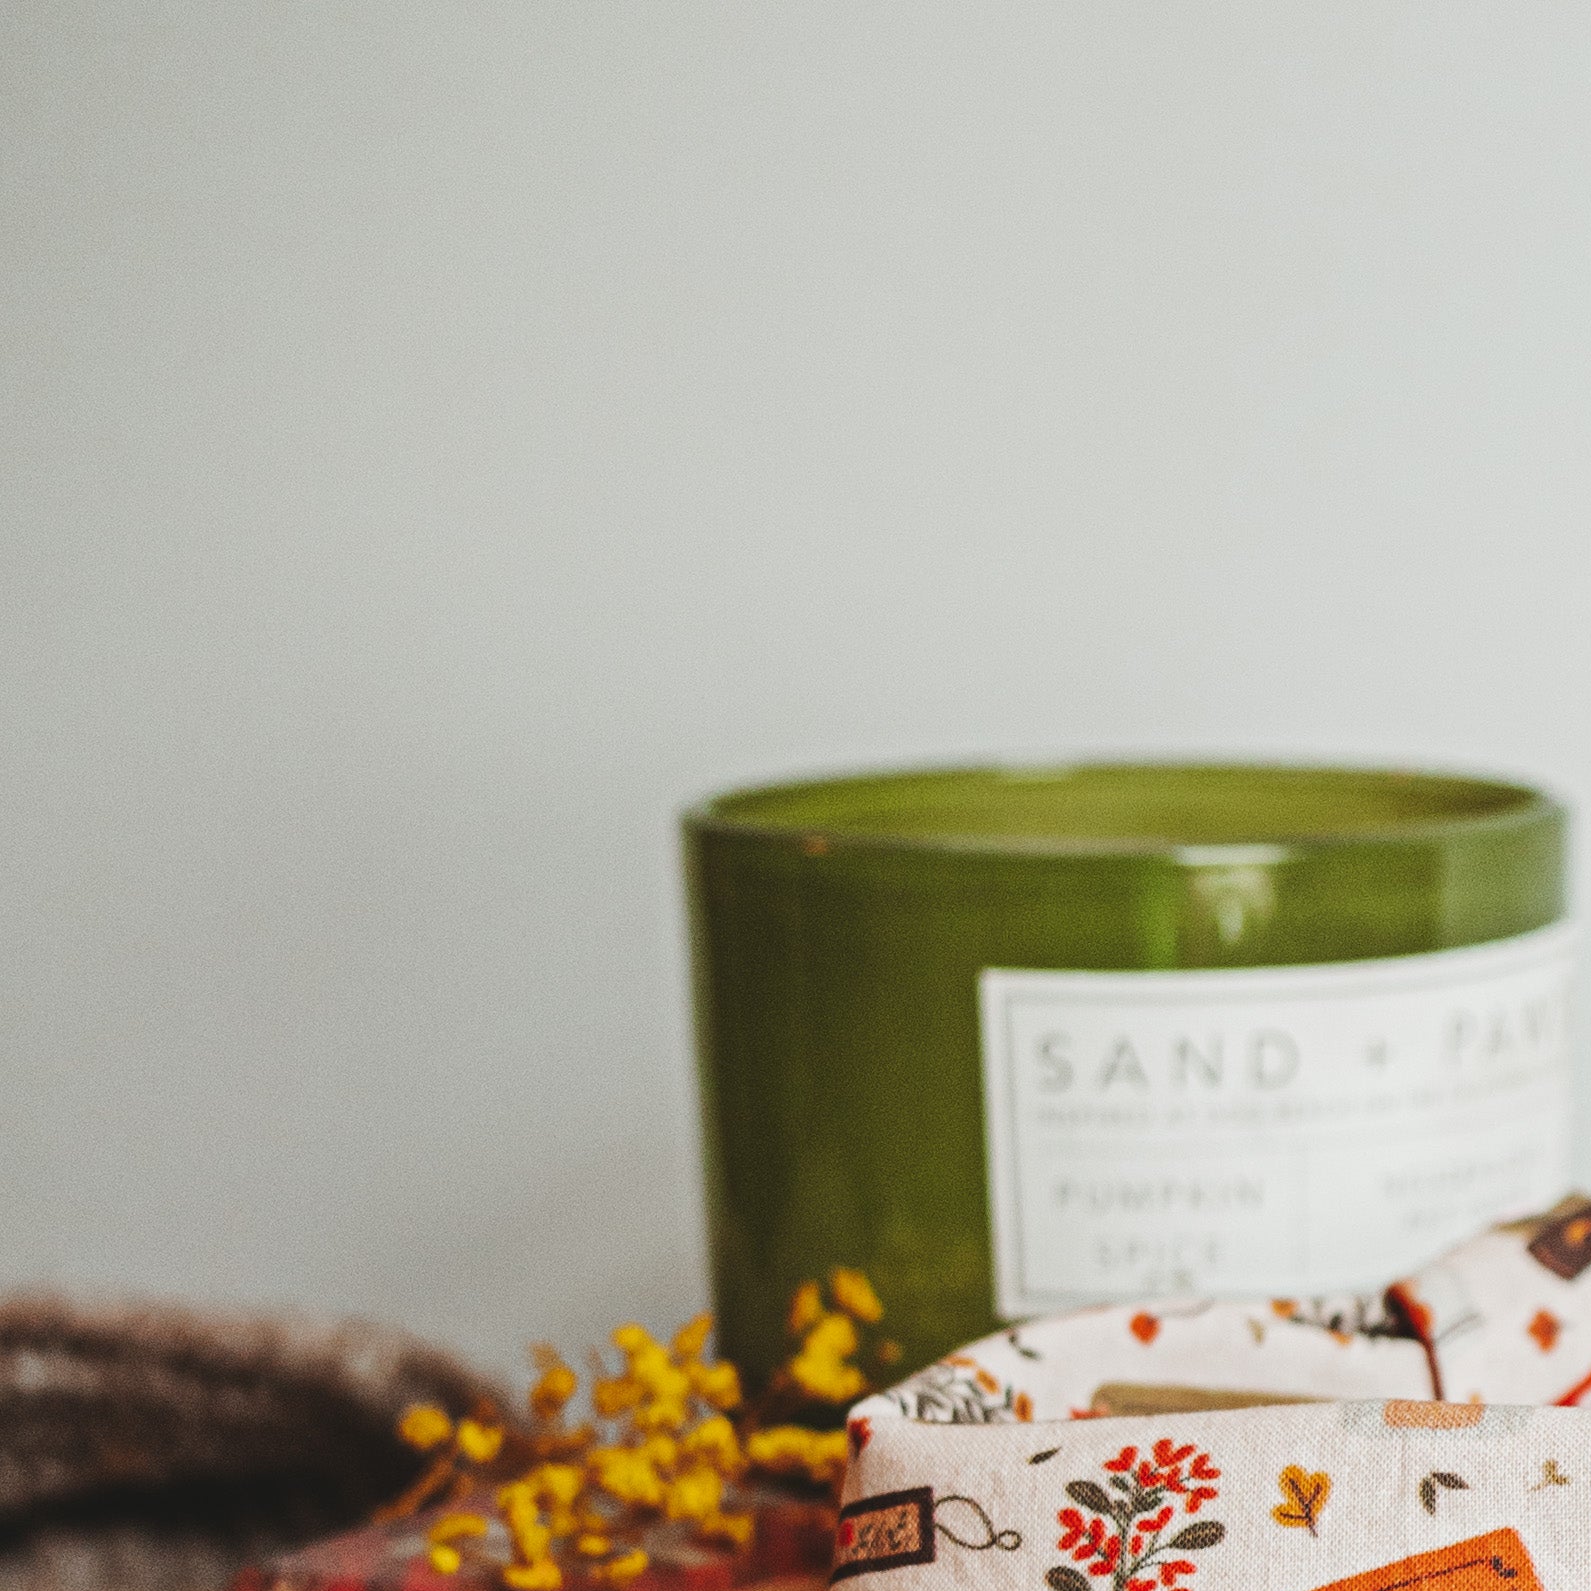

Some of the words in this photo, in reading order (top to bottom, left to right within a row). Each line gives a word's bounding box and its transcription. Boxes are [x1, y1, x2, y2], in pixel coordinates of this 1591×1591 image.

[1035, 1030, 1301, 1093] SAND
[1053, 1172, 1266, 1214] PUMPKIN
[1092, 1234, 1221, 1272] SPICE
